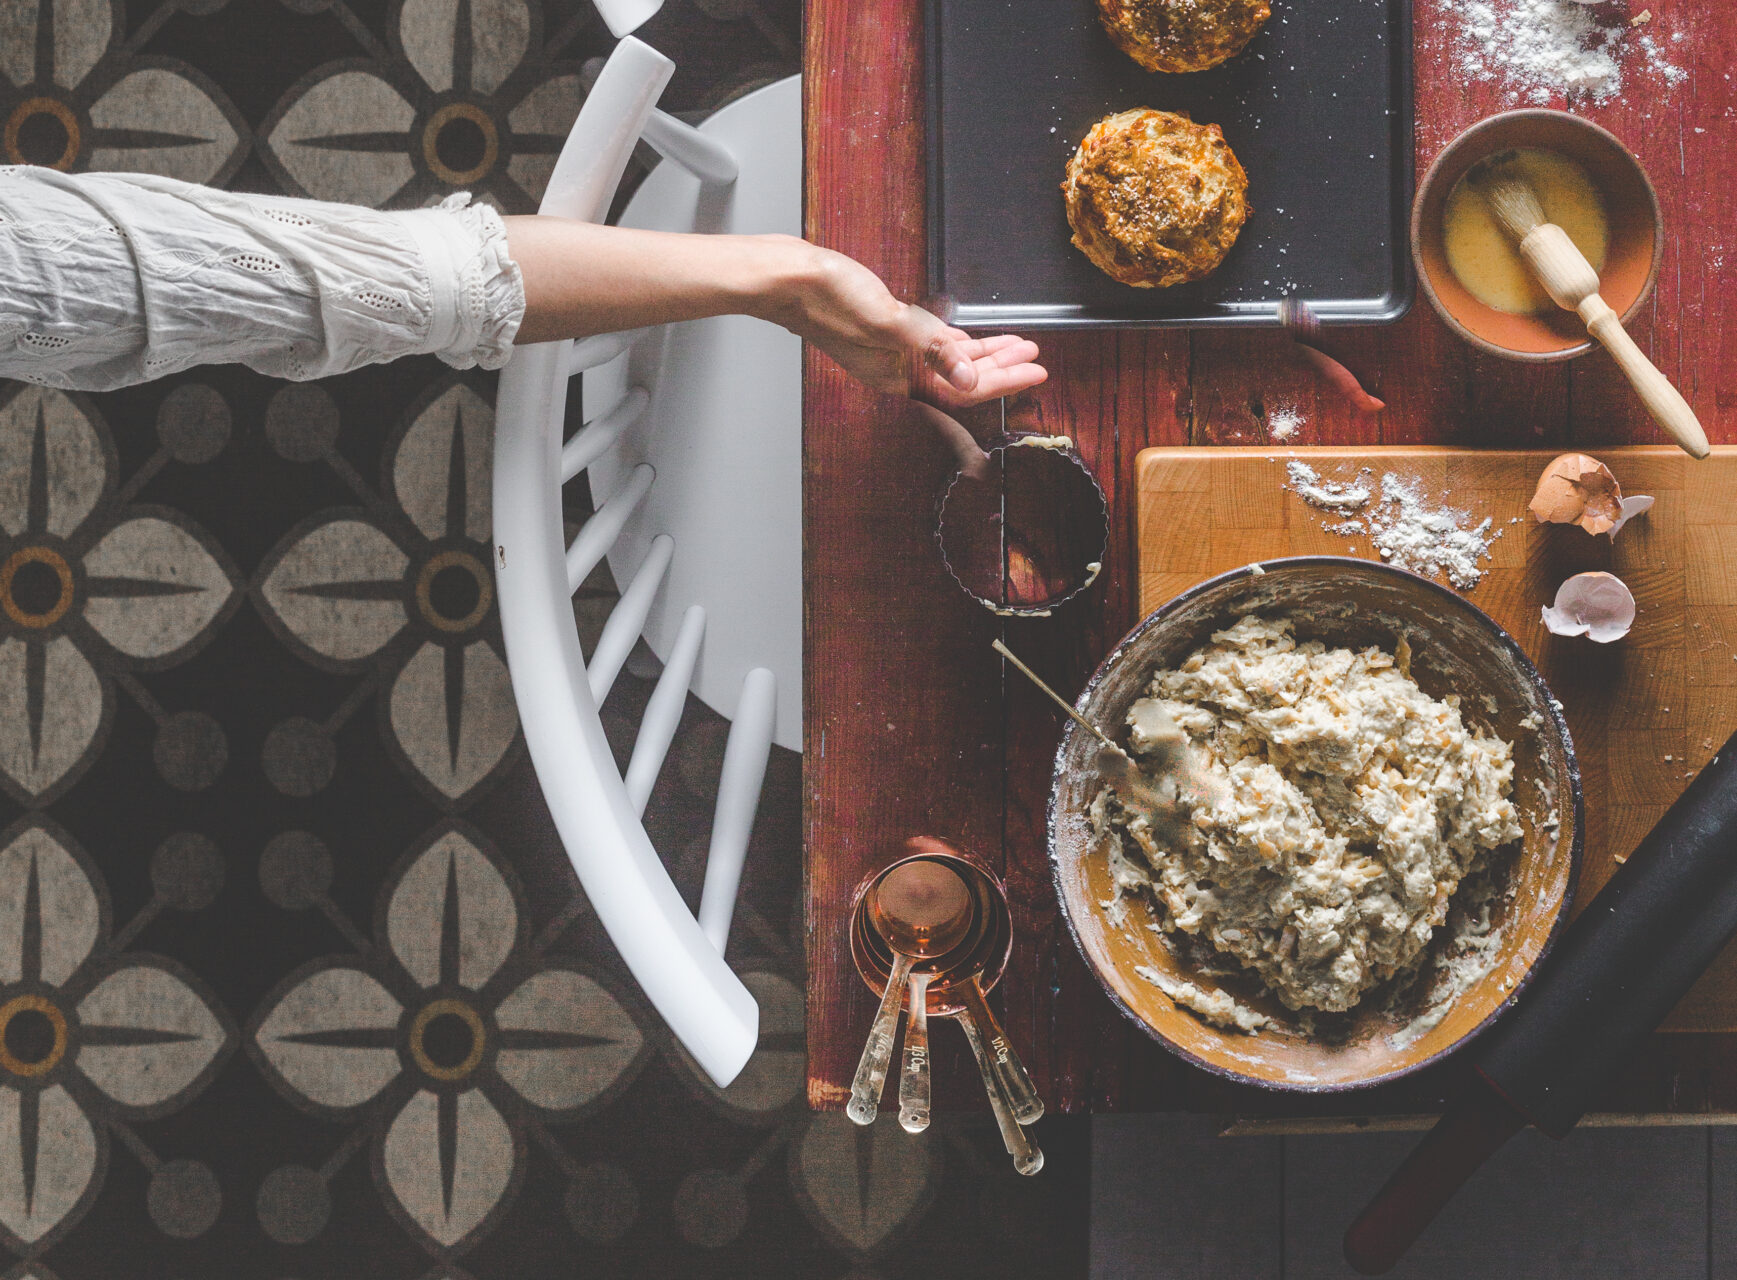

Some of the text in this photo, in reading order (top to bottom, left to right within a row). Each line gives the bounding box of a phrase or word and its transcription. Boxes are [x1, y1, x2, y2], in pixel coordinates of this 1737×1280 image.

[907, 1046, 926, 1072] 1/3 Cup
[991, 1036, 1008, 1065] 1/2 Cup
